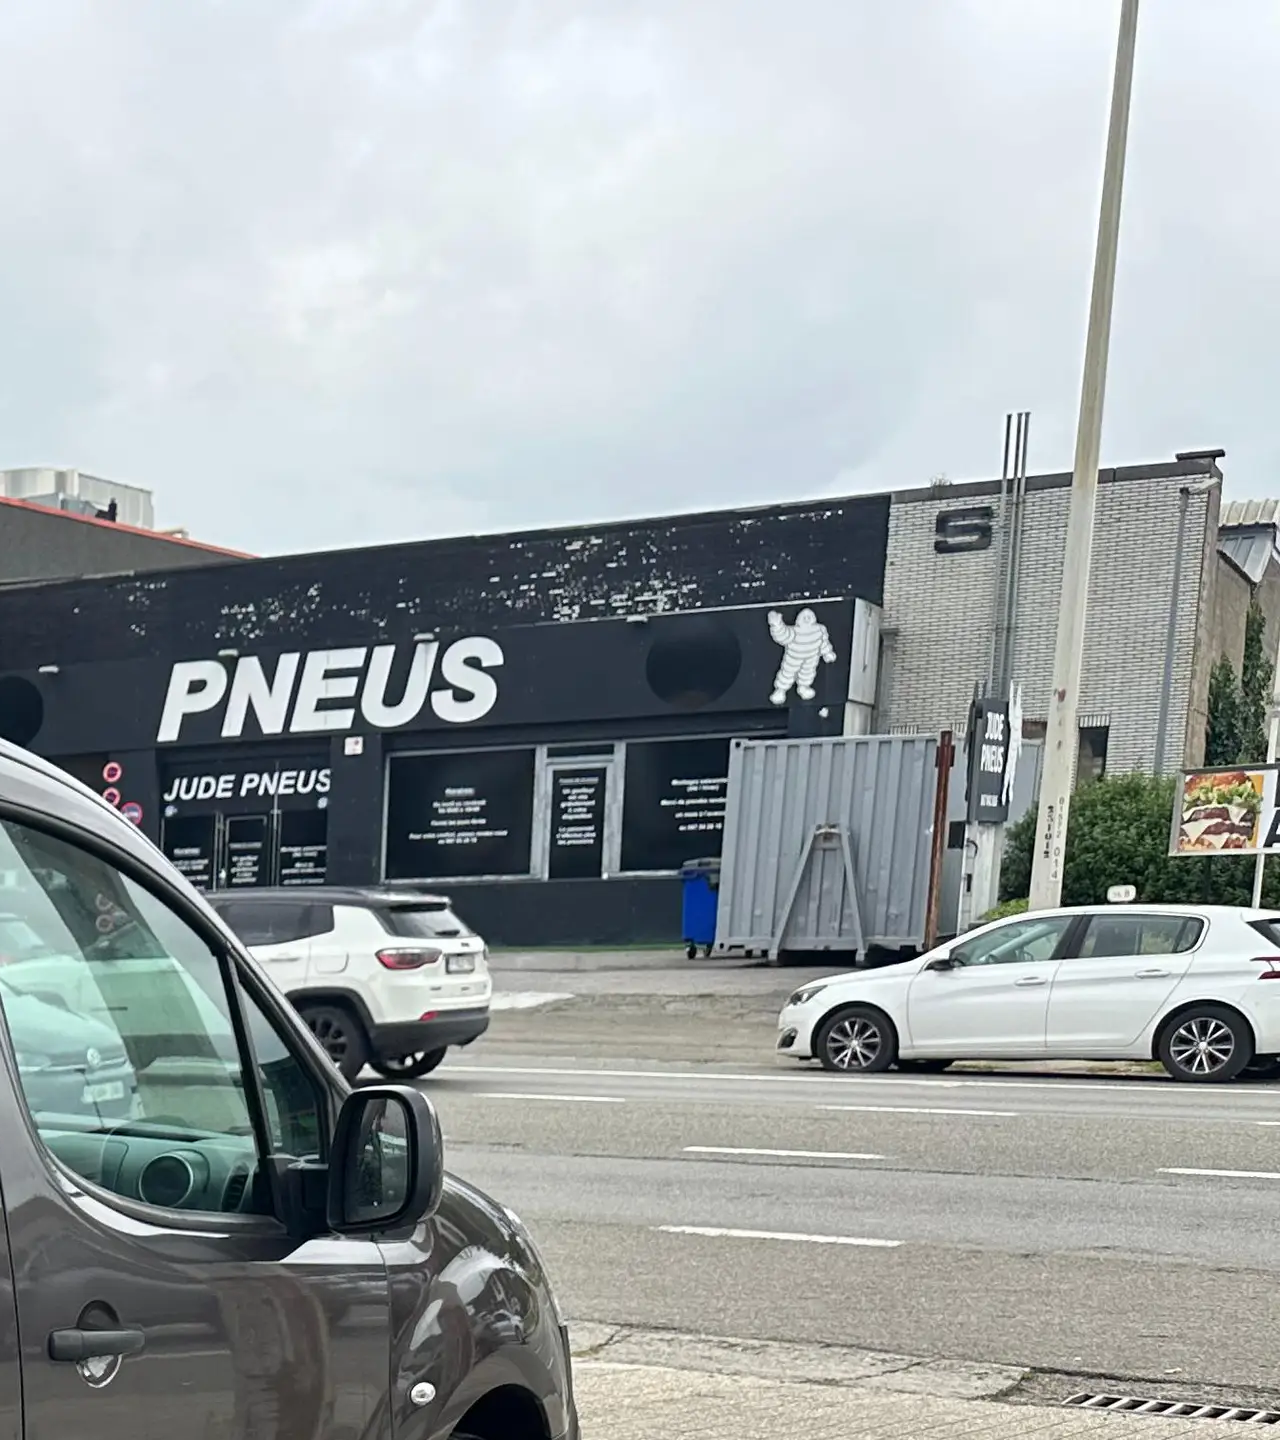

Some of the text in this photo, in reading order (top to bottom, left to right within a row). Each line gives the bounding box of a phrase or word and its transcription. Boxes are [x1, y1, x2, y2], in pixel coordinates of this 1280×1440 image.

[157, 635, 505, 743] PNEUS
[985, 711, 1005, 741] JUDE
[980, 743, 1005, 774] PNEUS
[164, 767, 332, 802] JUDE PNEUS
